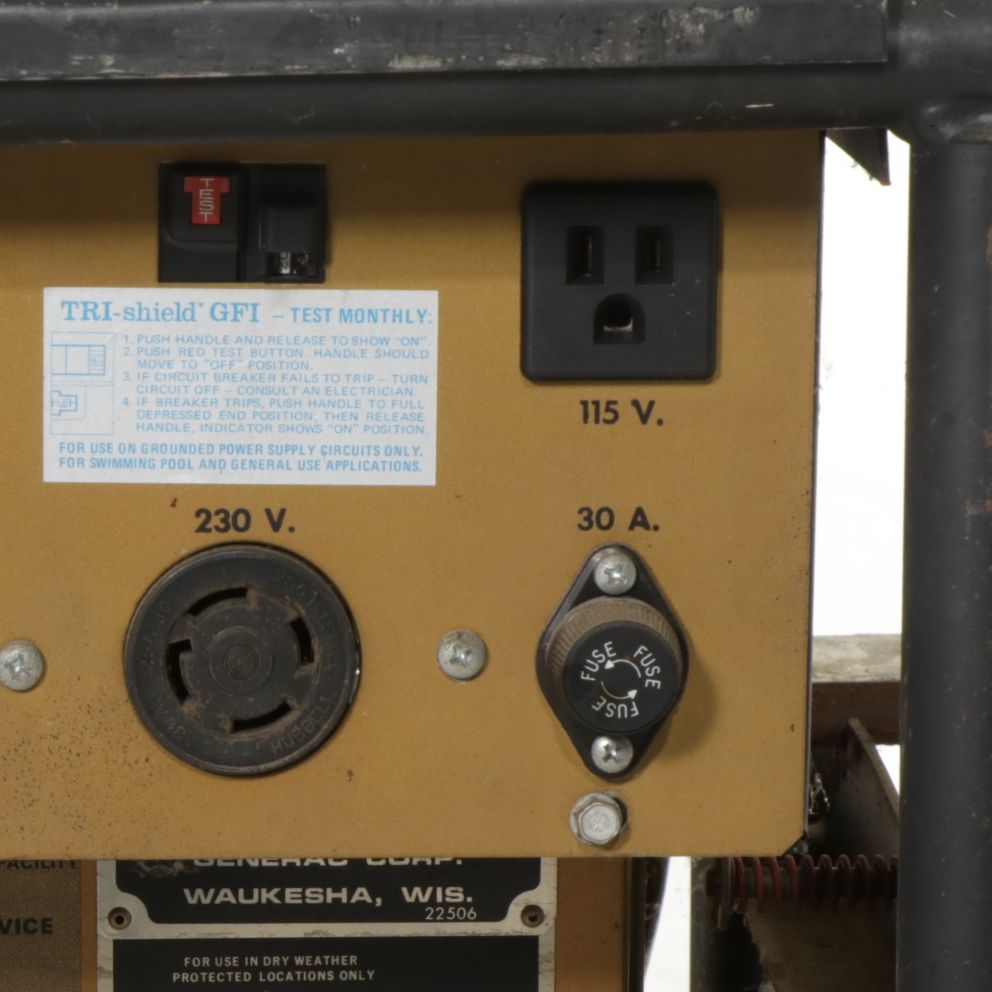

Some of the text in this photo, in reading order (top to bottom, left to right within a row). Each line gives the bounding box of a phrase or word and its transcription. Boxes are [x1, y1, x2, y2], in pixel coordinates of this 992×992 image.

[200, 178, 214, 222] TEST
[209, 301, 259, 322] GFI
[290, 307, 332, 323] TEST
[339, 307, 431, 324] MONTHLY:
[136, 334, 390, 346] PUSH HANDLE AND RELEASE TO SHOW
[136, 346, 429, 361] PUSH RED TEST HANDLE SHOULD
[137, 360, 198, 370] MOVE TO
[137, 371, 428, 384] IF CIRCUIT BREAKER FAILS TO TRIP TURN
[136, 384, 320, 396] CIRCUIT OFF CONSULT AN
[137, 397, 424, 409] IF BREAKER PUSH HANDLE TO FULL
[136, 409, 424, 422] DEPRESSED END THEN RELEASE
[580, 399, 663, 426] 115 V.
[200, 423, 322, 434] INDICATOR SHOWS
[59, 442, 422, 456] FOR USE ON GROUNDED POWER SUPPLY CIRCUITS ONLY.
[58, 457, 421, 471] FOR SWIMMING POOL AND GENERAL USE APPLICATIONS.
[195, 508, 295, 533] 230 V.
[577, 507, 659, 531] 30 A.
[580, 641, 616, 682] FUSE
[634, 645, 661, 689] FUSE
[592, 696, 639, 719] FUSE
[183, 886, 472, 907] WAUKESHA, WIS.
[425, 907, 477, 920] 22506
[184, 955, 357, 966] FOR USE IN DRY WEATHER
[172, 970, 374, 982] PROTECTED LOCATIONS ONLY
